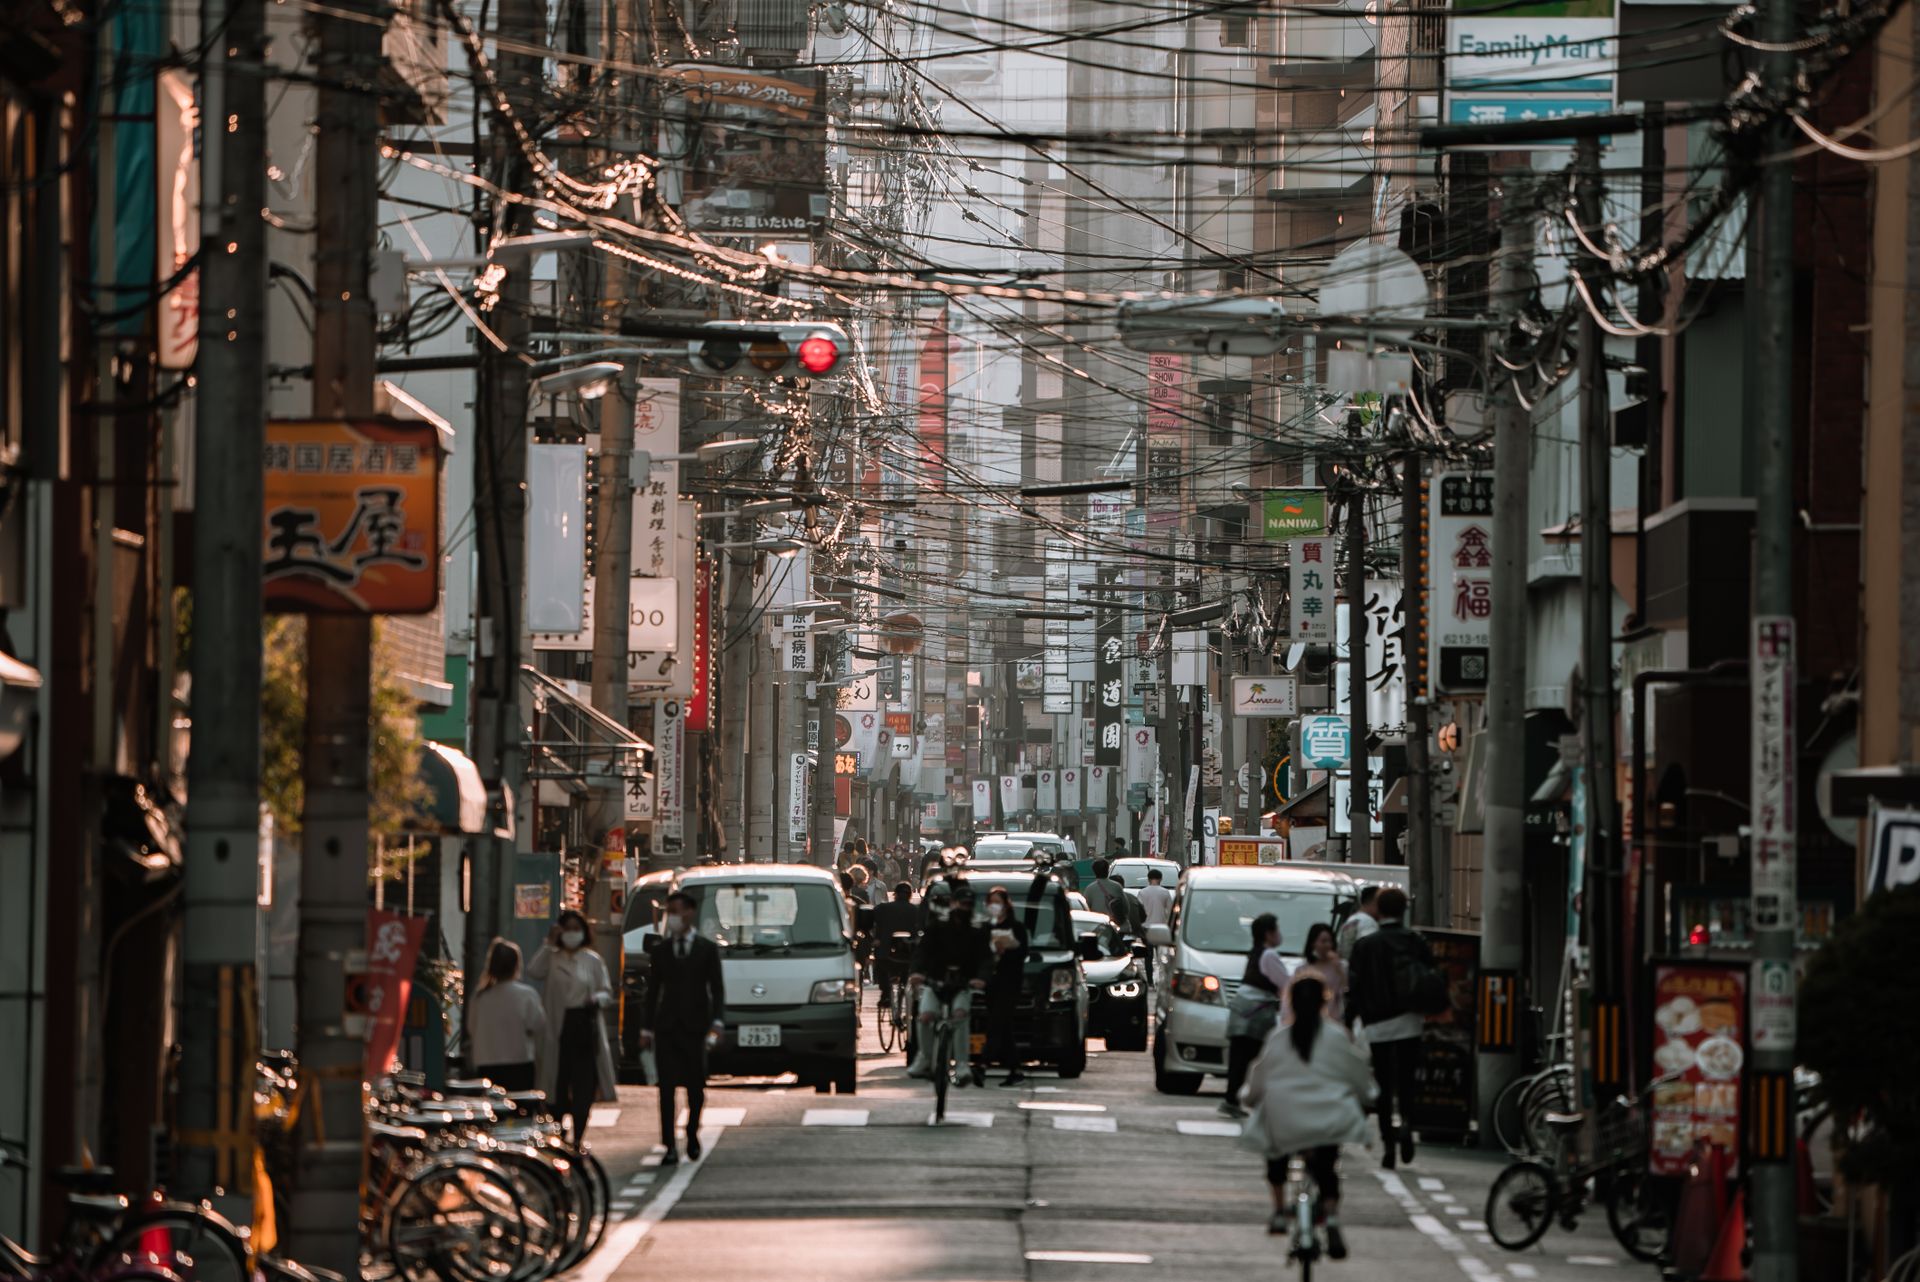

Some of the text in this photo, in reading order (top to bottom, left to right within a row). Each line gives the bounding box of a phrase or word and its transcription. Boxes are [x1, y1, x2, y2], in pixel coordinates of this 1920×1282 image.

[1459, 35, 1607, 65] FamilyMart
[1155, 357, 1172, 366] SEXY
[1155, 373, 1174, 382] SHOW
[1154, 388, 1168, 398] PUB
[1269, 518, 1319, 529] NANIWA
[1306, 720, 1350, 767] 質
[629, 802, 649, 813] ビル
